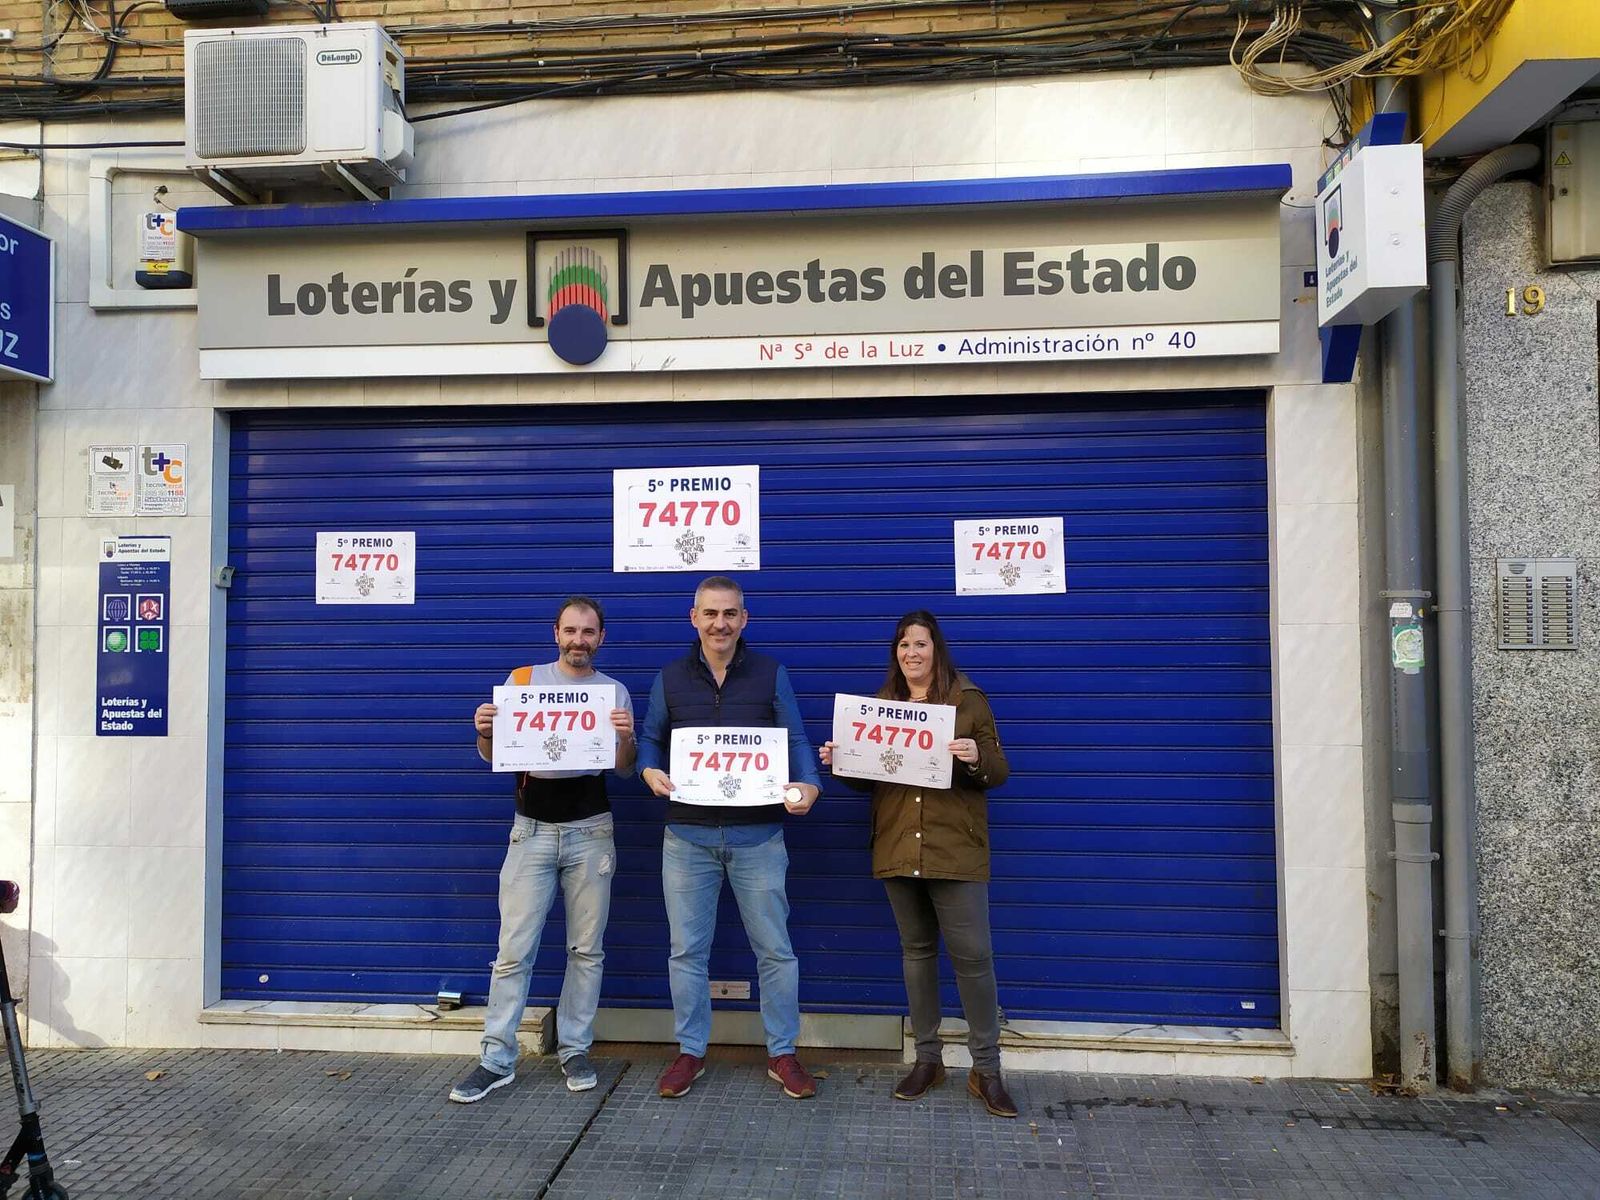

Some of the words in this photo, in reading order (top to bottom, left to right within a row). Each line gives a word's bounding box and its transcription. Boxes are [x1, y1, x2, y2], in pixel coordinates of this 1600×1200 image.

[321, 53, 358, 62] DeLonghi
[267, 268, 474, 316] Loterías
[488, 279, 518, 325] y
[639, 258, 887, 319] Apuestas
[903, 250, 984, 300] del
[1003, 243, 1197, 296] Estado
[1504, 285, 1546, 316] 19
[0, 330, 19, 359] Z
[824, 341, 849, 359] de
[861, 340, 878, 358] la
[889, 340, 925, 358] Luz
[958, 333, 1120, 356] Administración
[1168, 331, 1196, 350] 40
[670, 477, 732, 493] PREMIO
[638, 499, 741, 528] 74770
[994, 525, 1039, 536] PREMIO
[352, 538, 394, 548] PREMIO
[972, 541, 1046, 561] 74770
[331, 554, 399, 571] 74770
[101, 697, 139, 707] Loterías
[141, 699, 147, 708] y
[539, 692, 589, 704] PREMIO
[101, 709, 145, 720] Apuestas
[147, 708, 163, 718] del
[513, 710, 596, 732] 74770
[878, 706, 928, 722] PREMIO
[101, 720, 134, 730] Estado
[714, 734, 762, 745] PREMIO
[852, 721, 933, 750] 74770
[689, 751, 769, 772] 74770
